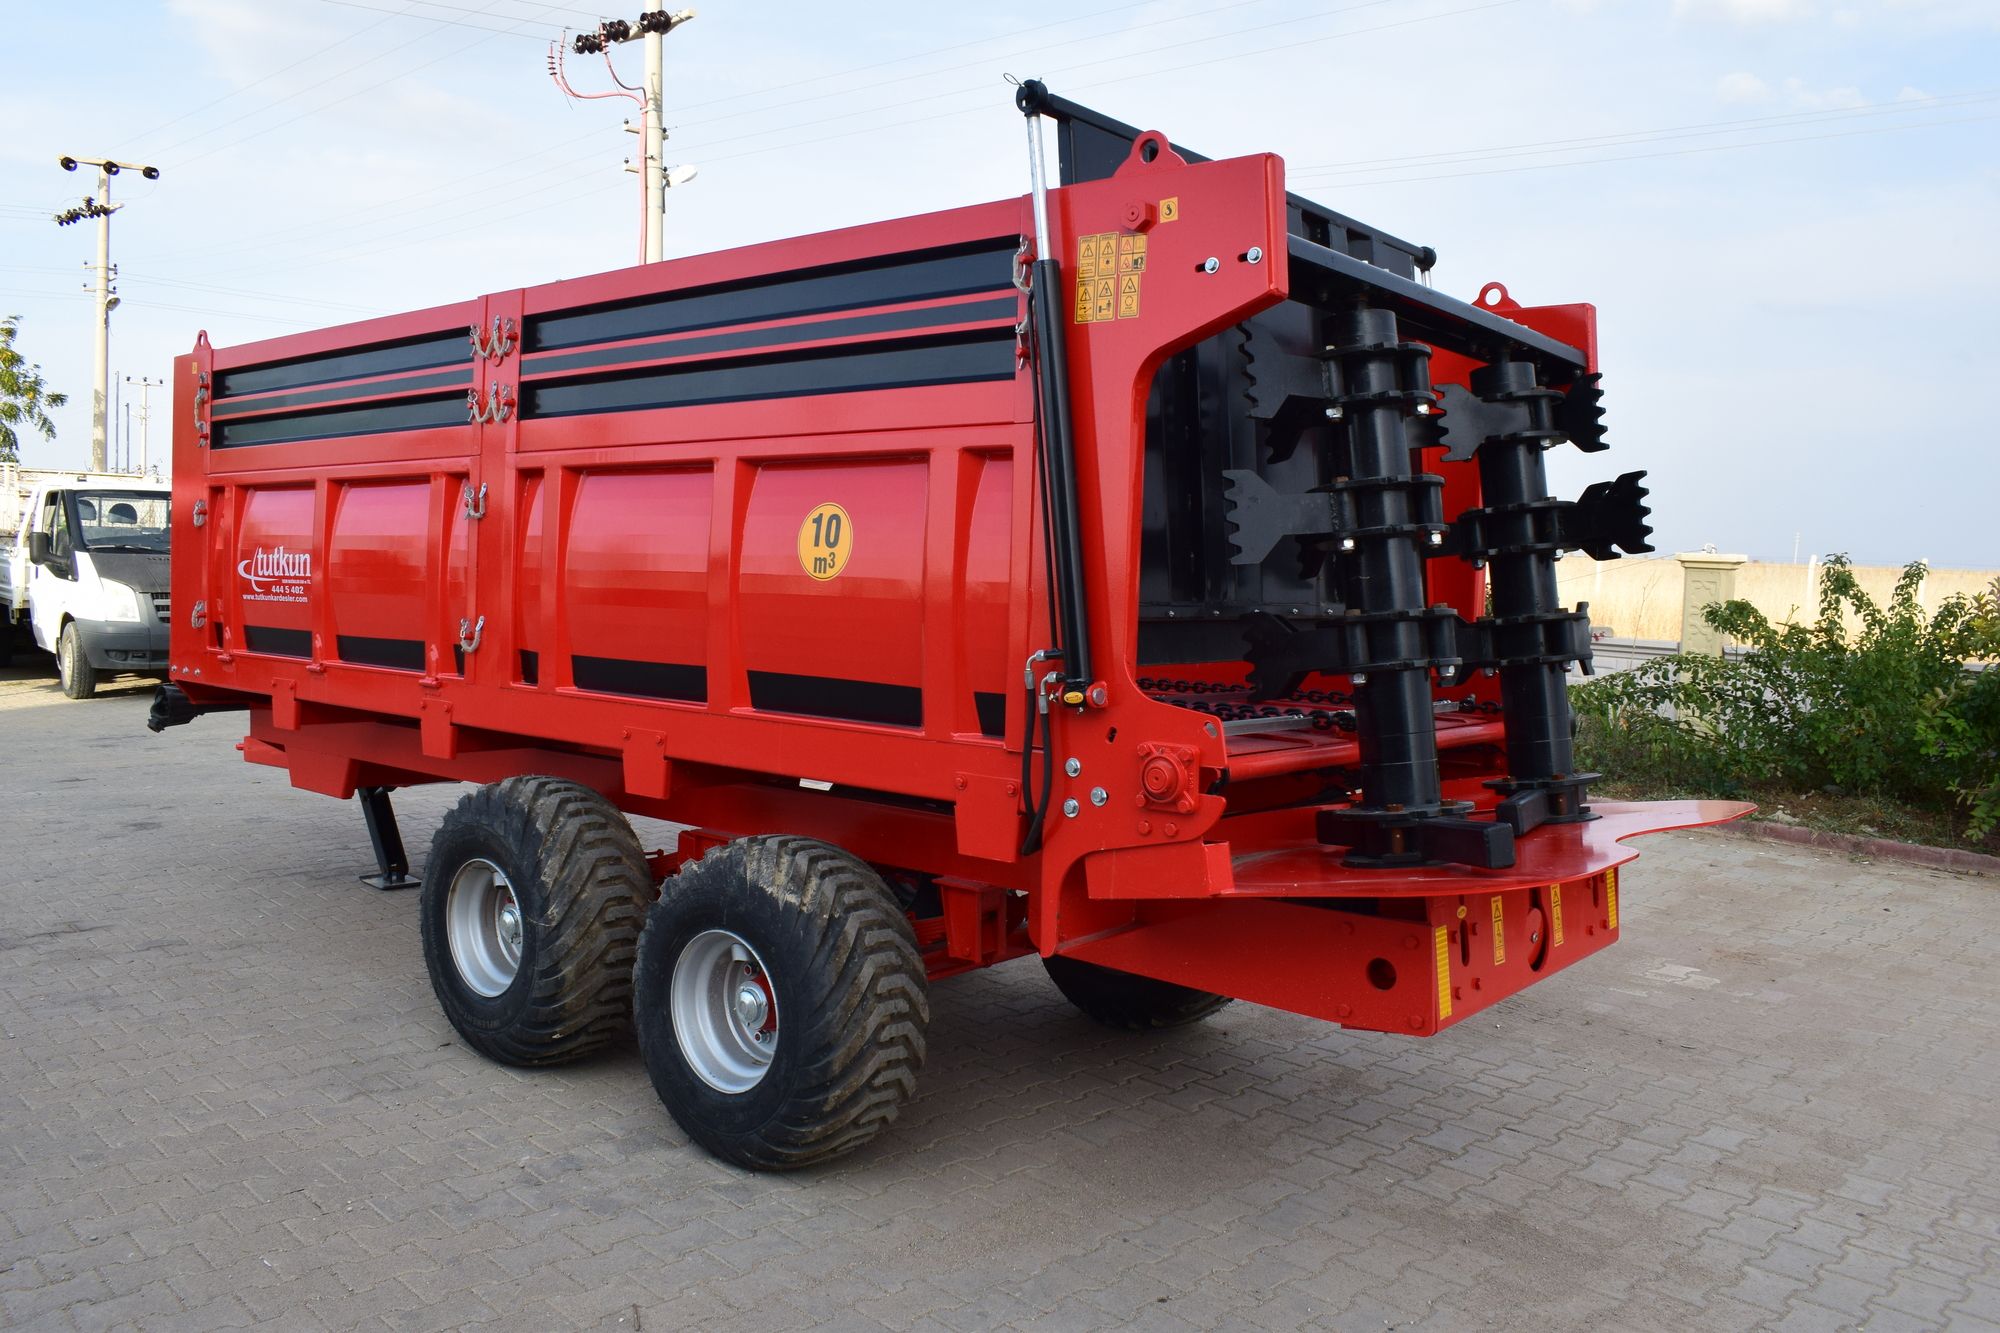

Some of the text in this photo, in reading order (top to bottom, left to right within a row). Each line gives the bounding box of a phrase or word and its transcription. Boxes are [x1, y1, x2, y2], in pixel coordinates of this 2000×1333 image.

[812, 513, 841, 548] 10
[257, 546, 311, 576] tutkun
[271, 585, 284, 594] 444
[285, 585, 290, 594] 5
